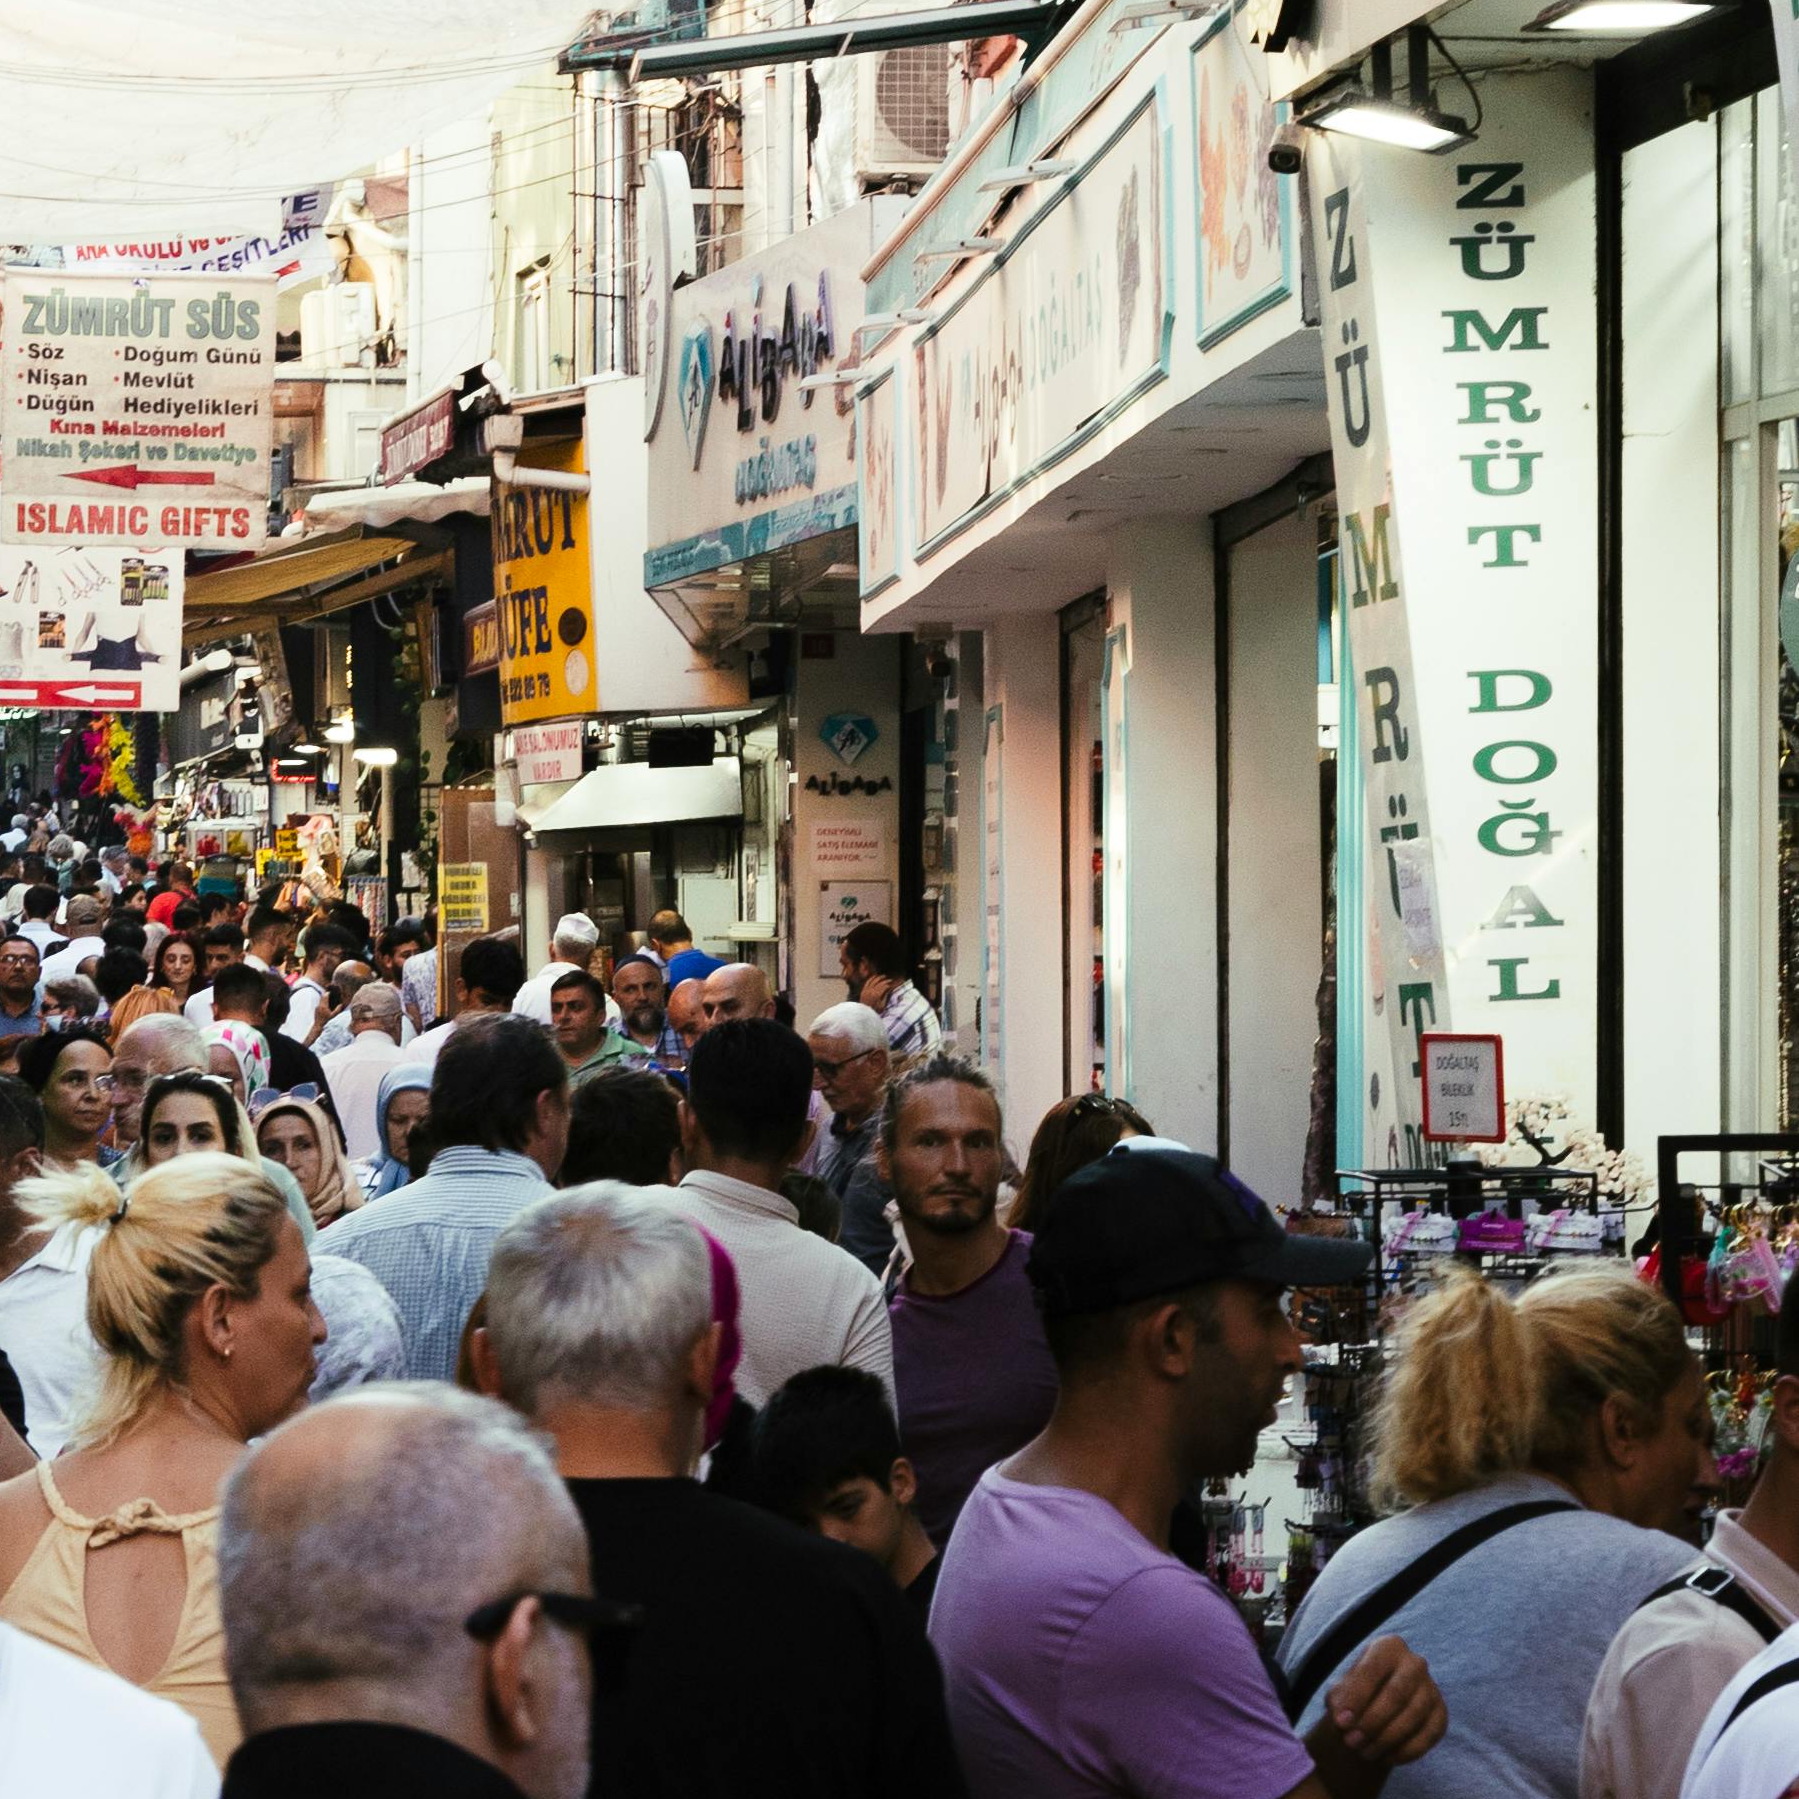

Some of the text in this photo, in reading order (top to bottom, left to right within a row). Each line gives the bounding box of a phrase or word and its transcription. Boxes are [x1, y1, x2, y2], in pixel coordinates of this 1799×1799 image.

[22, 288, 260, 340] ZÜMRÜT SÜS
[28, 343, 64, 361] Söz
[124, 345, 261, 366] Doğum Günü
[27, 369, 88, 390] Nişan
[123, 371, 194, 389] Mevlüt
[27, 394, 95, 415] Düğün
[124, 397, 259, 419] Hediyelikleri
[50, 419, 226, 438] Kına Malzemeleri
[16, 438, 257, 466] Nikah Şekeri ve Davetiye
[17, 503, 251, 538] ISLAMIC GIFTS
[1443, 163, 1563, 1001] ZÜMRÜT DOĞAL
[498, 574, 552, 661] ÜFE
[805, 771, 892, 796] ALİBABA
